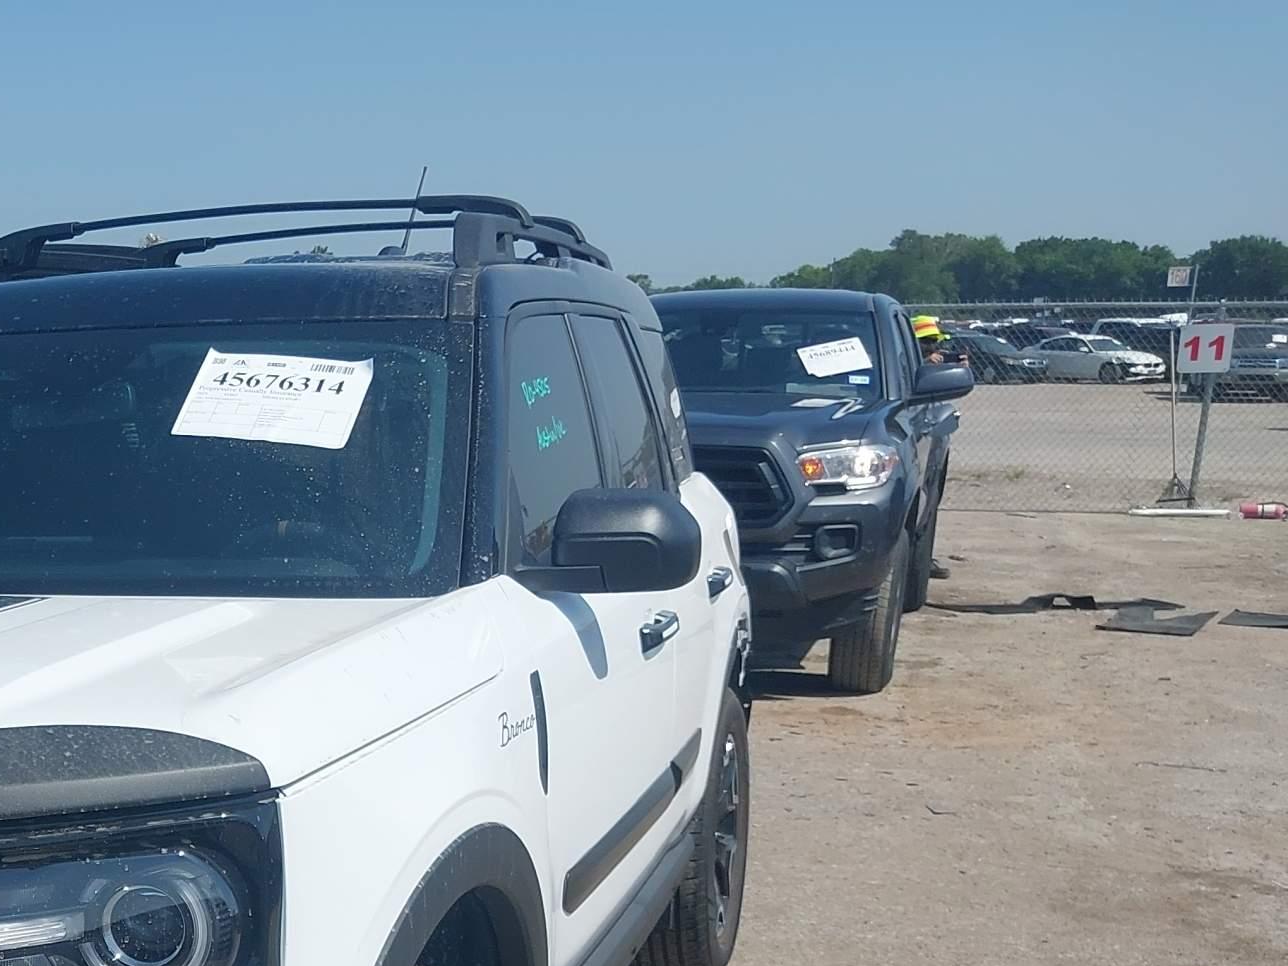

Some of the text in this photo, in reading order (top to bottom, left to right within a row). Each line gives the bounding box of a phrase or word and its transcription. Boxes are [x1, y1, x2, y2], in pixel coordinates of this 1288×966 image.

[1183, 335, 1226, 361] 11
[212, 371, 346, 396] 45676314
[497, 711, 536, 748] Bronco
